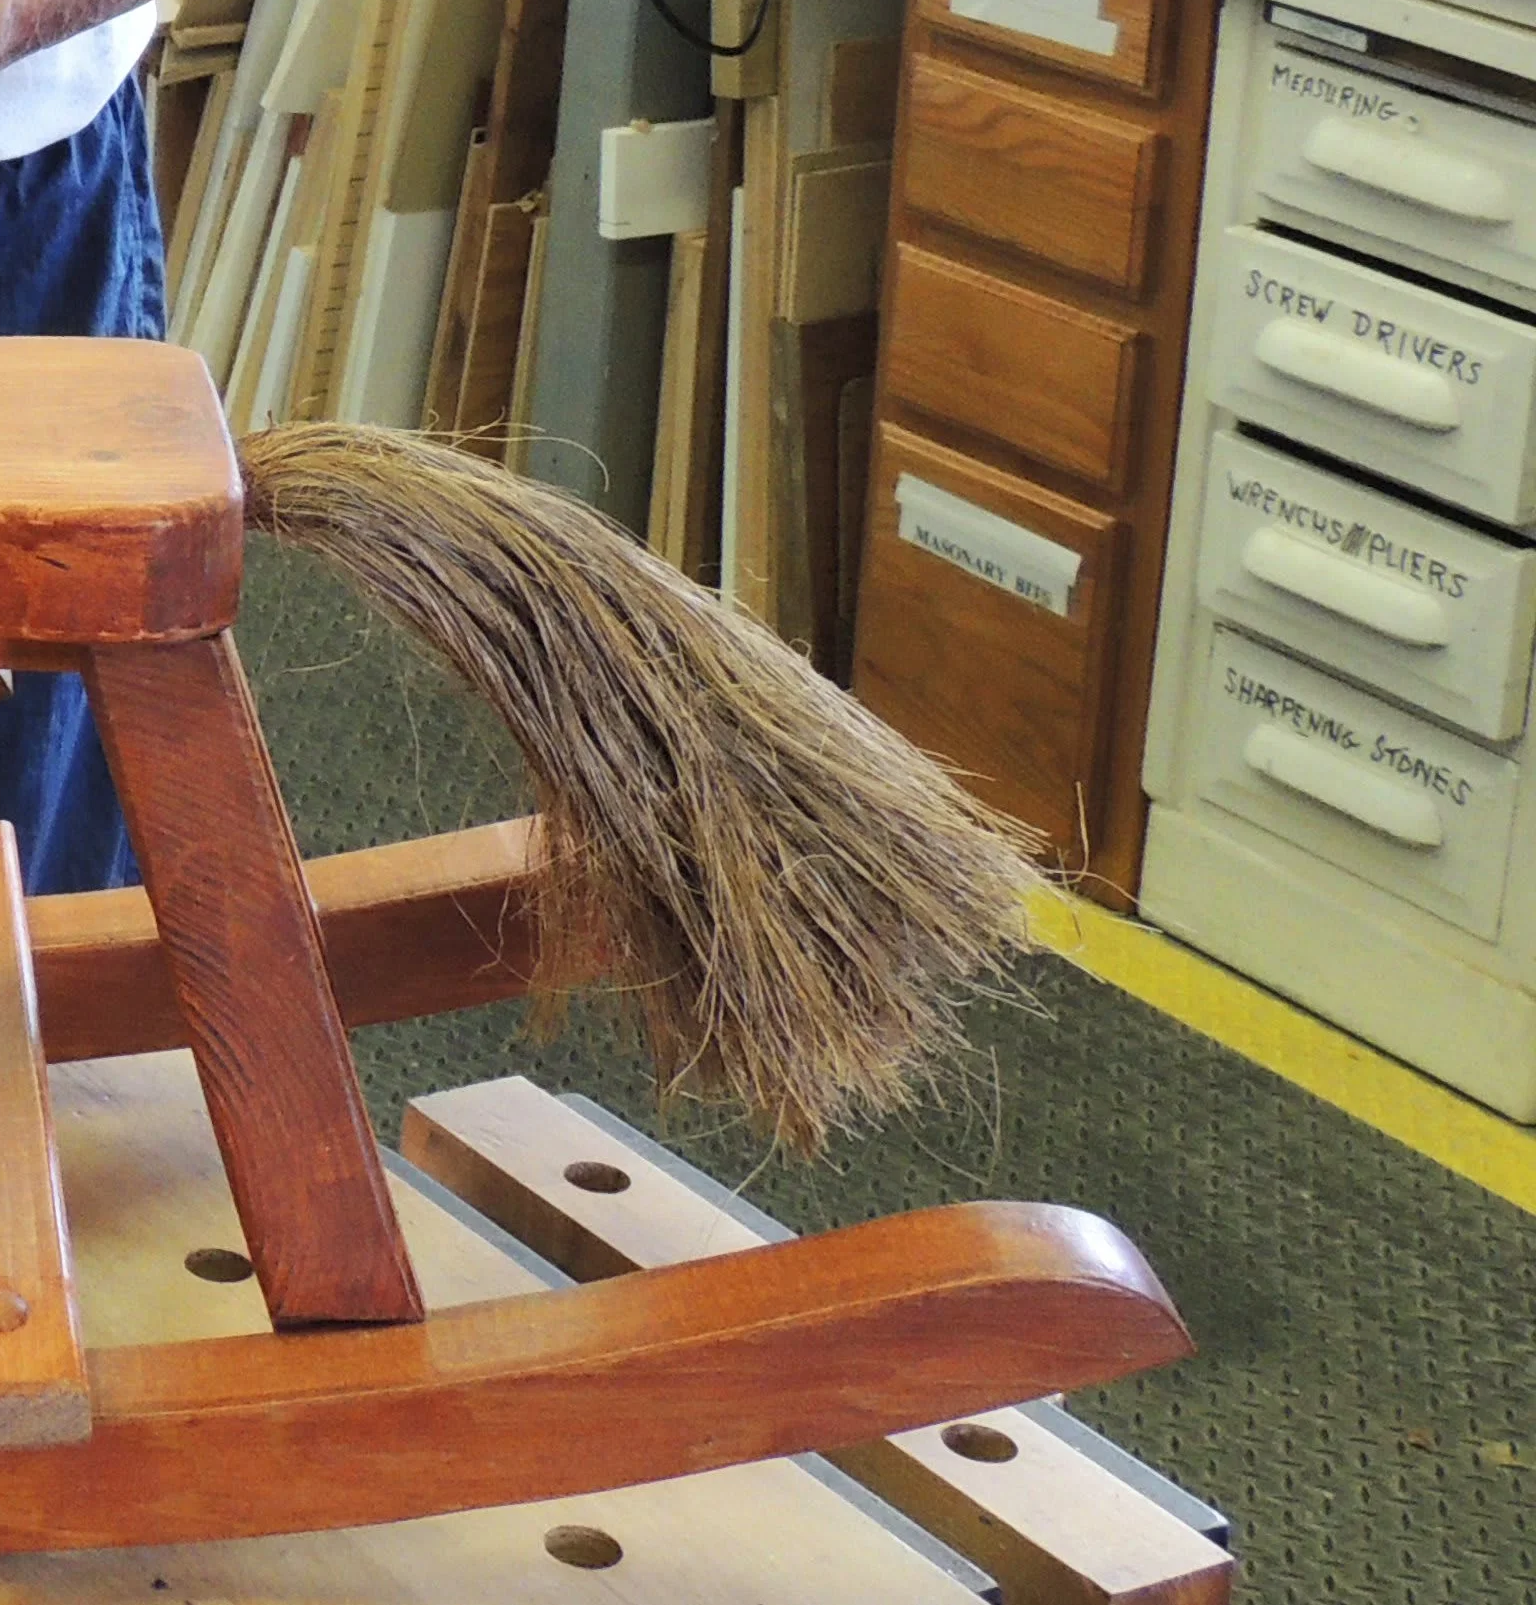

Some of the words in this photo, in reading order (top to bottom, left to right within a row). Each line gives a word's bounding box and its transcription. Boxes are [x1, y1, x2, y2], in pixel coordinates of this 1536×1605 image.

[1272, 63, 1400, 122] MEASURING
[1245, 268, 1335, 324] SCREW
[1352, 309, 1483, 386] DRIVERS
[915, 524, 1008, 584] MASONARY
[1367, 532, 1469, 600] PLIERS
[1224, 666, 1361, 751] SHARPENING
[1369, 733, 1474, 807] STONES
